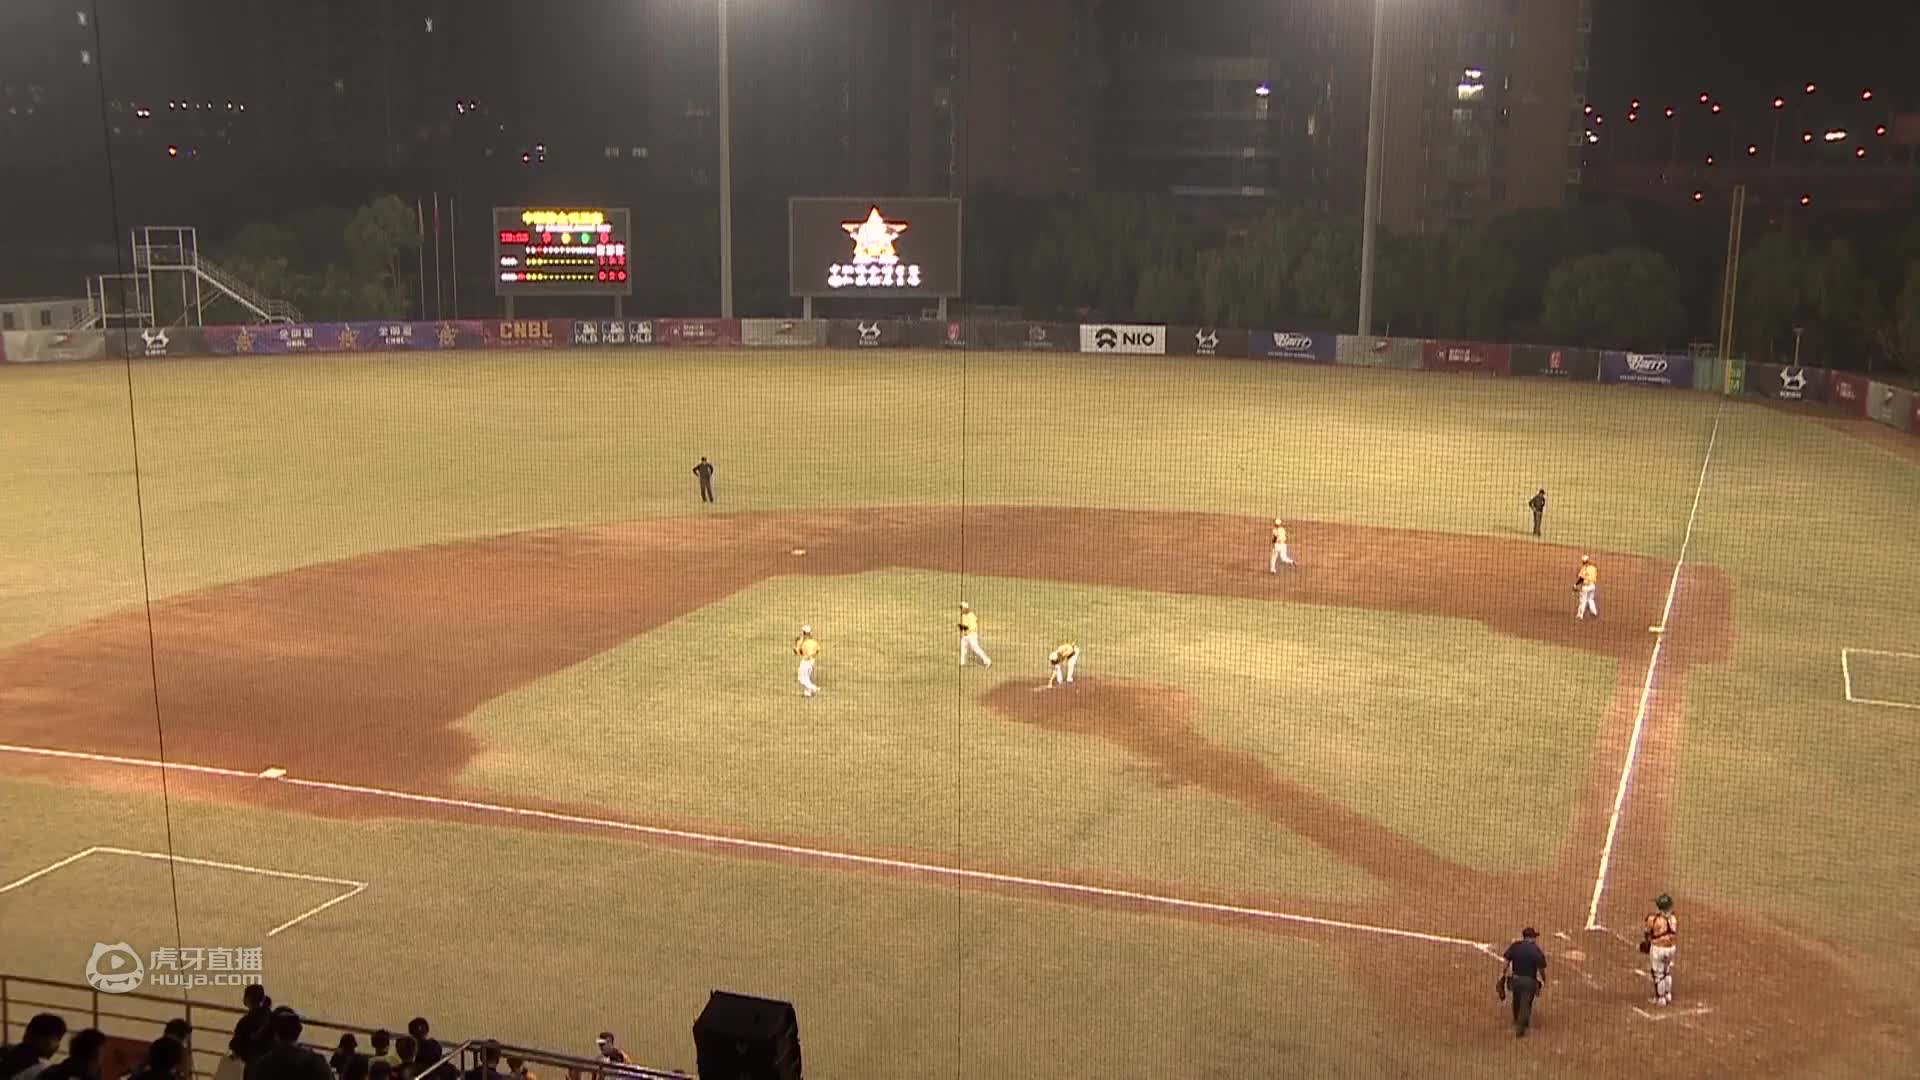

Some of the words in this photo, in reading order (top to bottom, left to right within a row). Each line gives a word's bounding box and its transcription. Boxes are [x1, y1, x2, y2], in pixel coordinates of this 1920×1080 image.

[500, 321, 553, 338] CNBL
[575, 334, 598, 344] MLB
[602, 334, 625, 344] MLB
[629, 334, 652, 344] MLB
[1122, 332, 1155, 346] NIO
